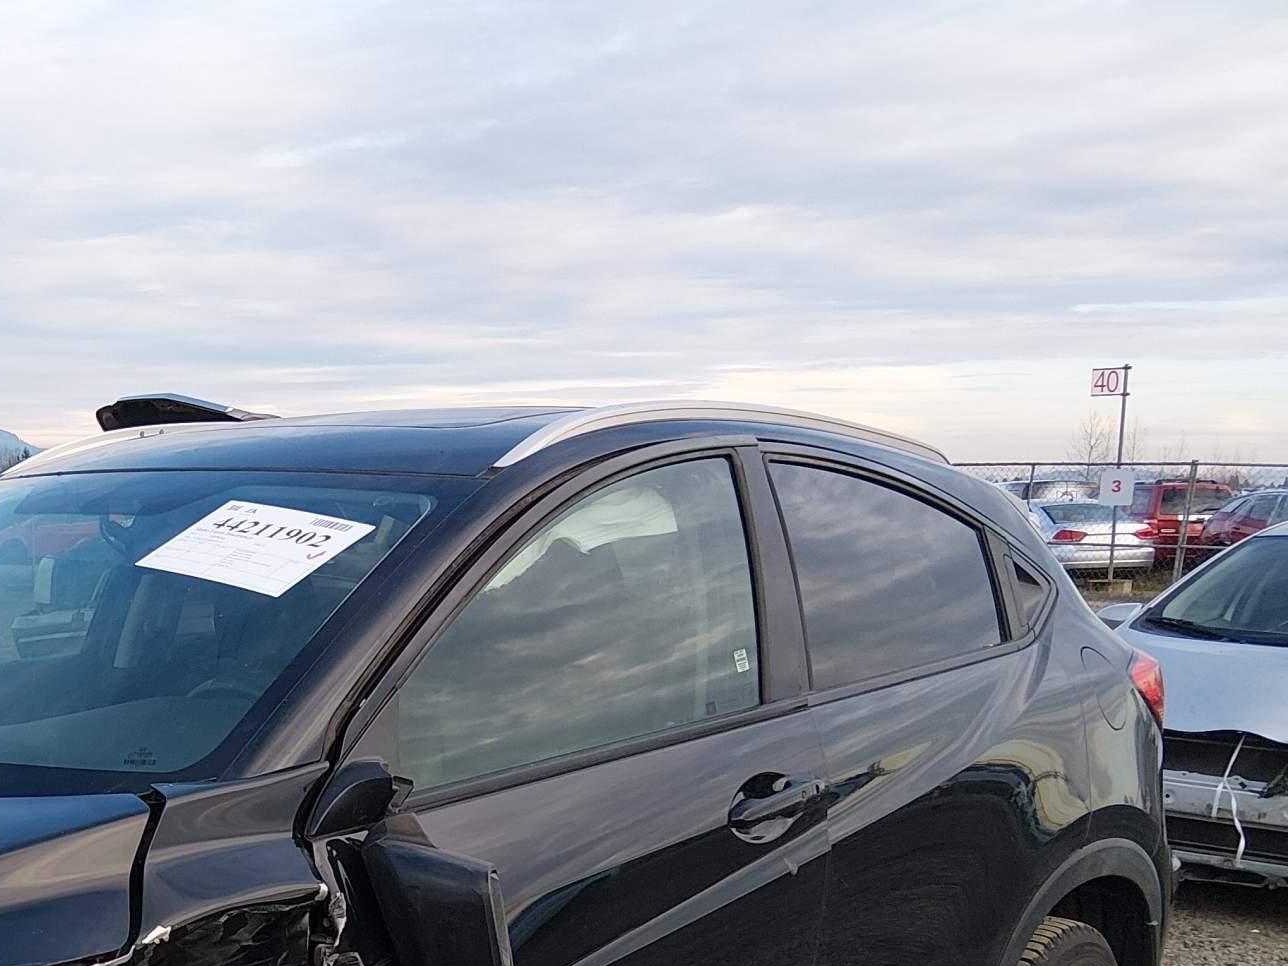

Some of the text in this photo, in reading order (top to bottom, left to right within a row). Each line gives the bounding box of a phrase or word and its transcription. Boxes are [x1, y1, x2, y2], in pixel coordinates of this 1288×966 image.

[1094, 370, 1119, 393] 40
[1111, 479, 1122, 493] 3
[212, 517, 331, 548] 44211902
